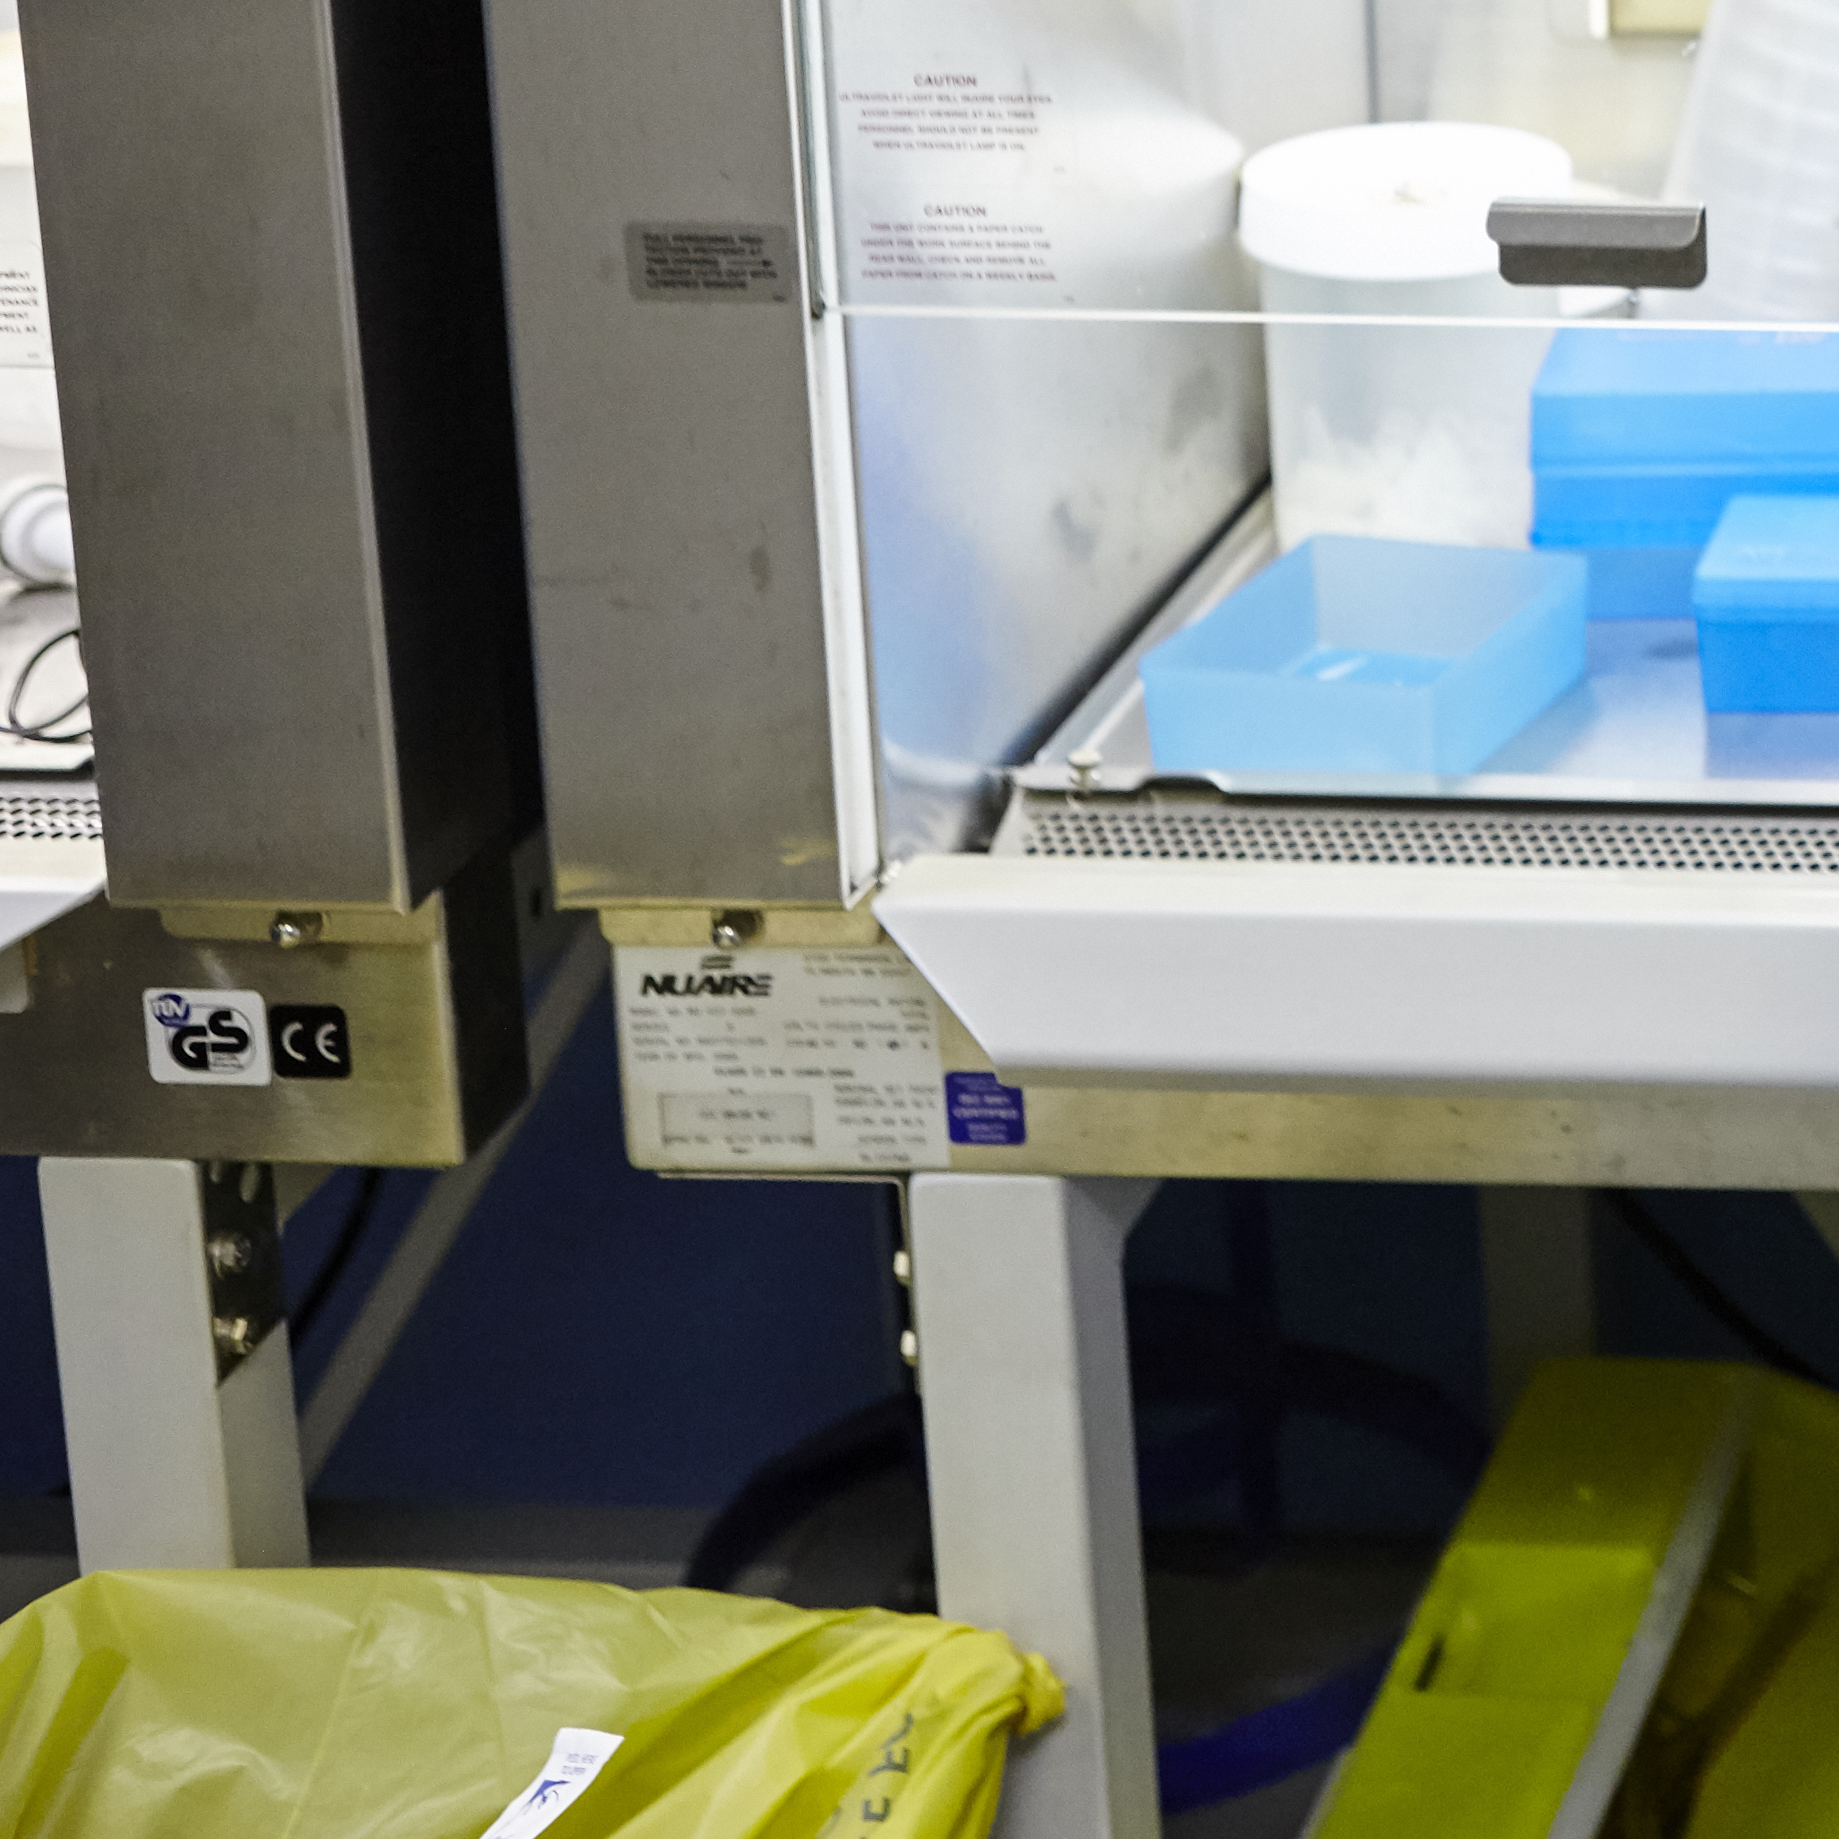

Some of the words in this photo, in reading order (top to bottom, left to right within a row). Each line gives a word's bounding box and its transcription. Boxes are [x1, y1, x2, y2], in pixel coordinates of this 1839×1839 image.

[914, 74, 977, 87] CAUTION
[924, 205, 987, 217] CAUTION
[172, 1010, 249, 1070] GS
[282, 1021, 341, 1062] CE
